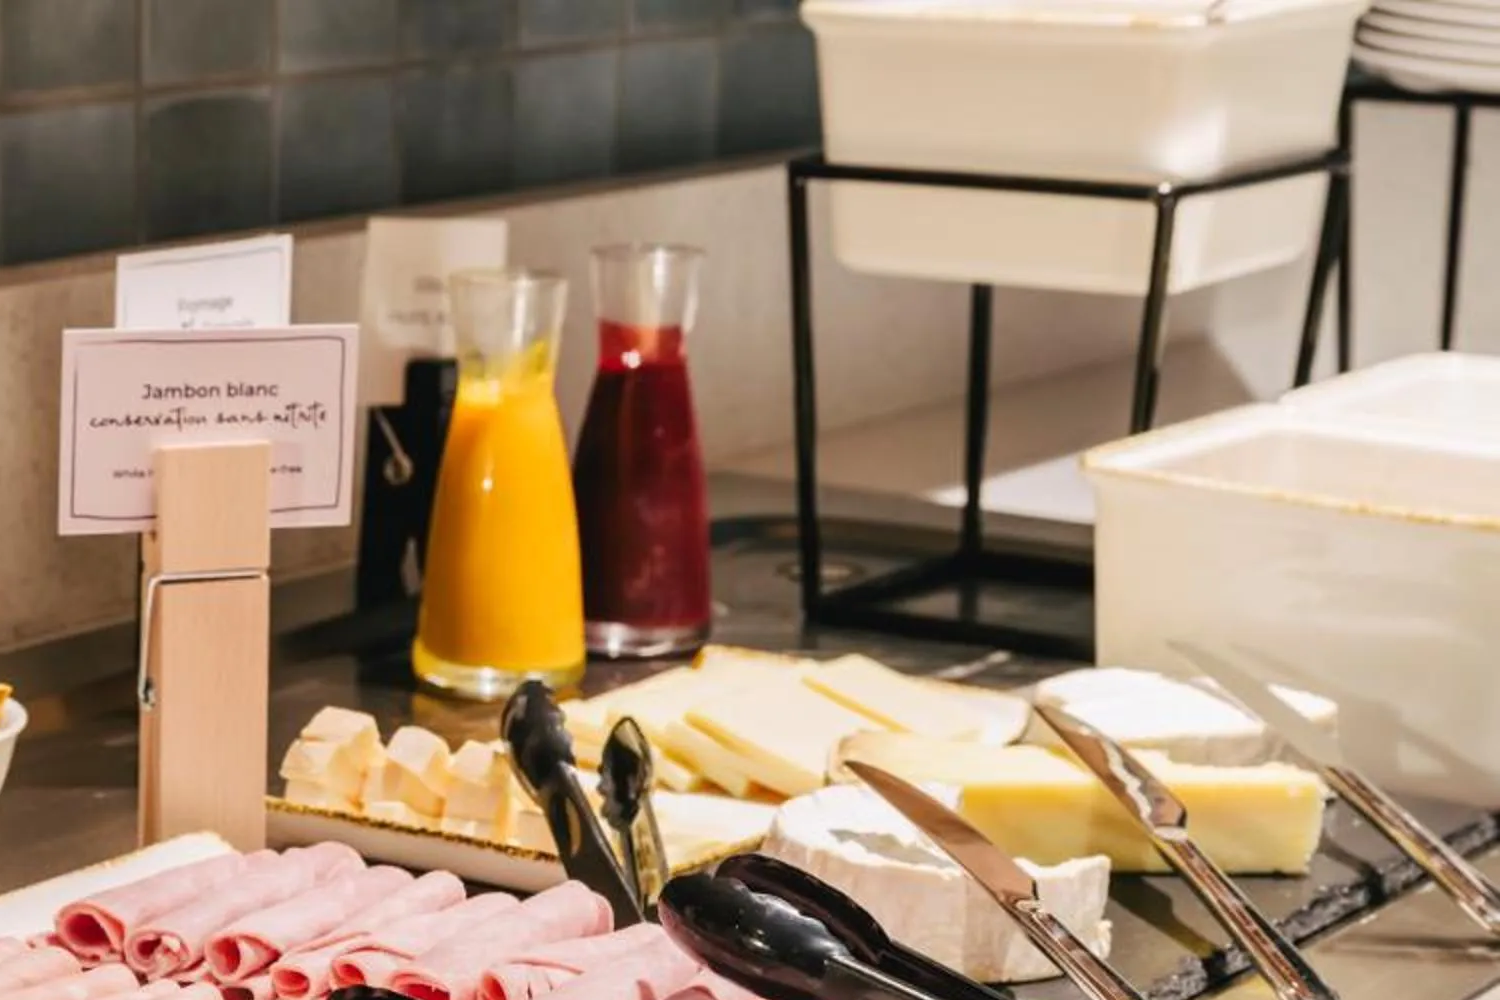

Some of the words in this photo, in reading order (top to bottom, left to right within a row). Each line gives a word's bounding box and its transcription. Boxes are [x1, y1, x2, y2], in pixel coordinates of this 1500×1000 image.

[141, 383, 221, 400] Jambon
[226, 382, 279, 398] blanc
[89, 407, 208, 432] conservation
[216, 411, 266, 425] sans
[273, 402, 327, 430] nitrite
